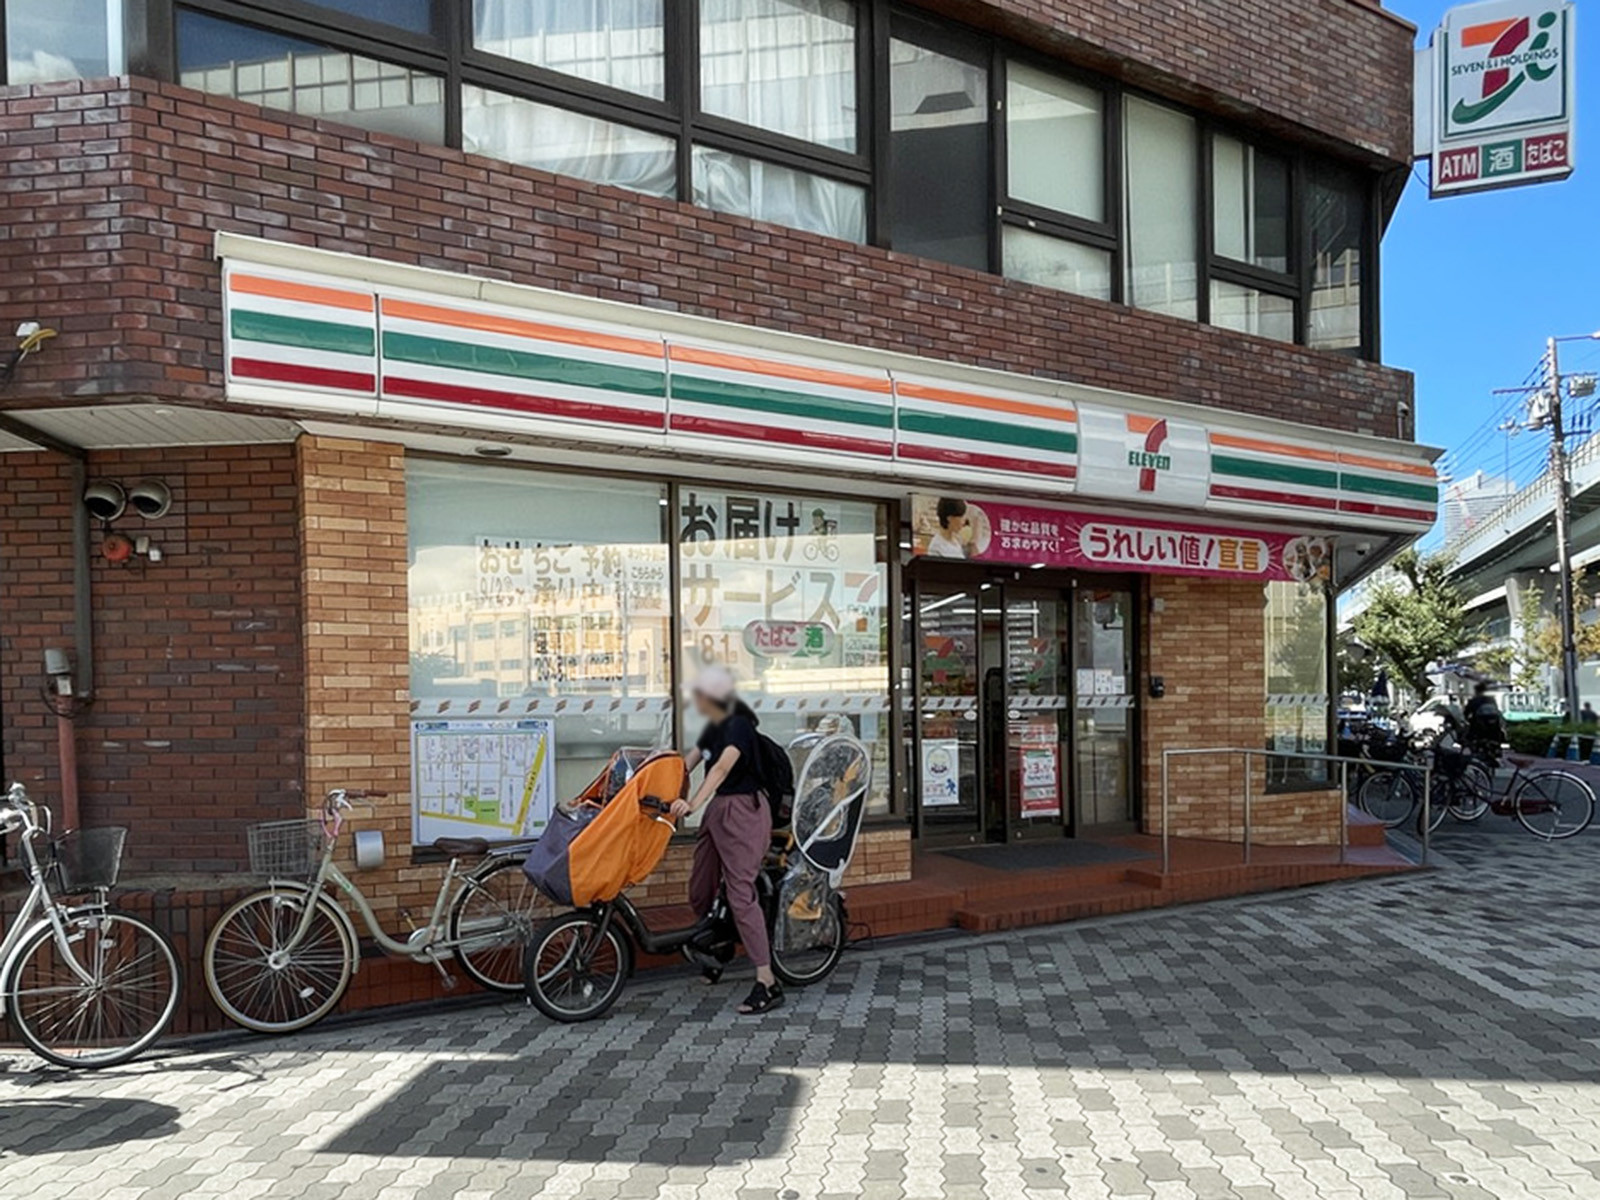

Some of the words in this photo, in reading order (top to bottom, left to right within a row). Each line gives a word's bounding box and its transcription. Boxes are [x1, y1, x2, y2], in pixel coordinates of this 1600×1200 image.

[1451, 61, 1486, 76] SEVEN
[1500, 47, 1559, 68] HOLDINGS
[1441, 152, 1477, 179] ATM
[1489, 146, 1515, 173] 酒
[1526, 140, 1566, 166] たばこ
[680, 492, 801, 562] お届け
[682, 563, 841, 633] サービス
[755, 624, 798, 647] たばこ
[804, 625, 824, 649] 酒
